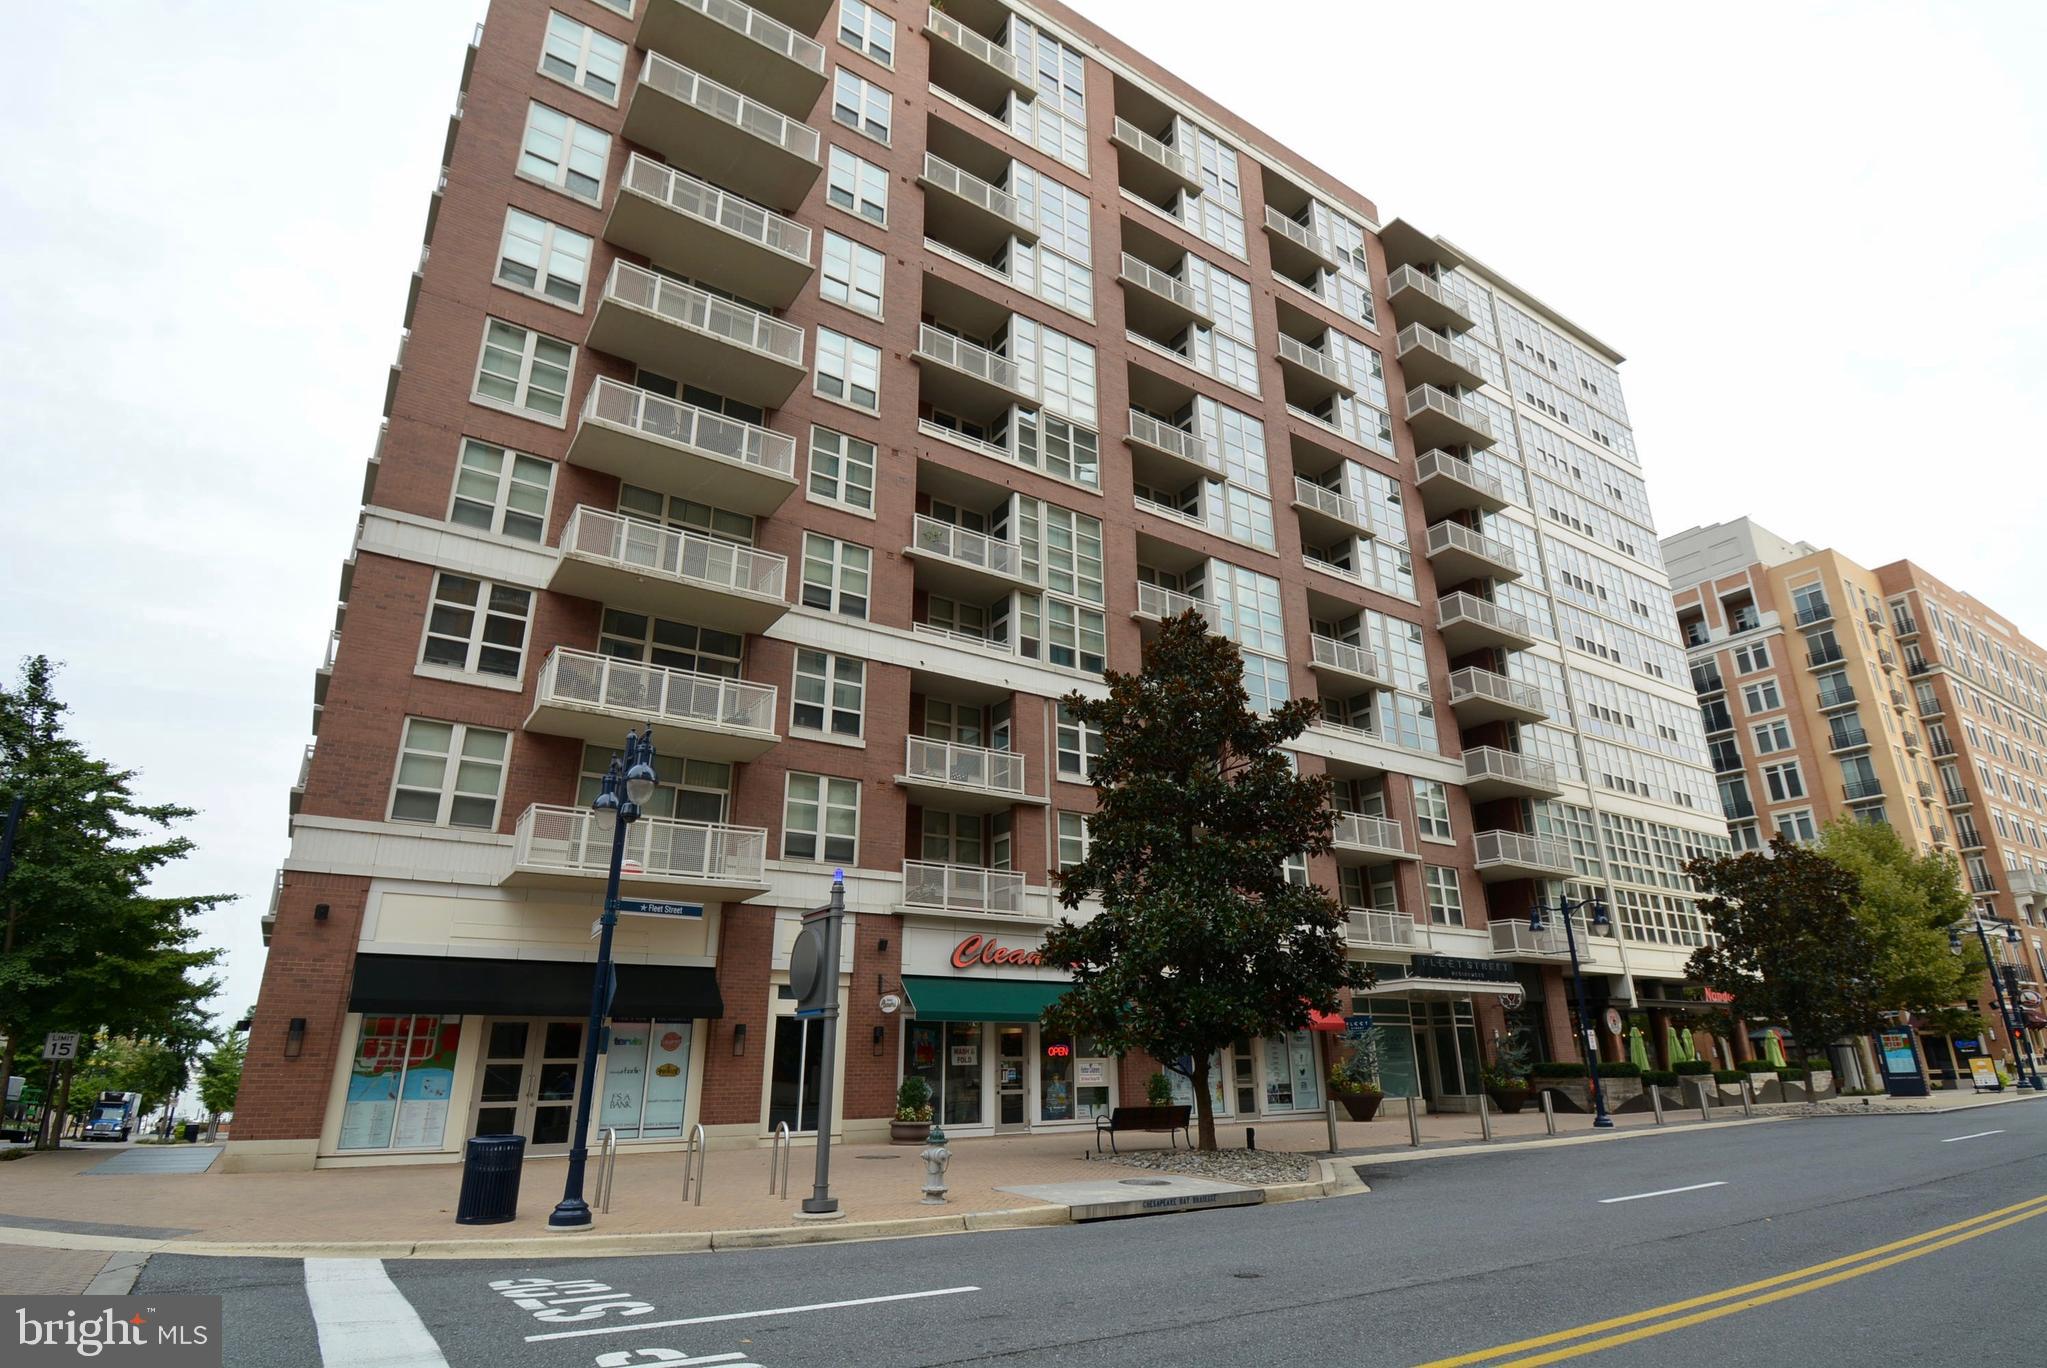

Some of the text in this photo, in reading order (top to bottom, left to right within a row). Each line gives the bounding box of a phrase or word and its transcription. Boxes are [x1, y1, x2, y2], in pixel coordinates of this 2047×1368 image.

[648, 904, 683, 914] Fleet Street
[951, 933, 1081, 968] Clean
[1422, 958, 1508, 971] FLEET STREET
[50, 1043, 72, 1056] 15
[1048, 1046, 1069, 1056] OPEN
